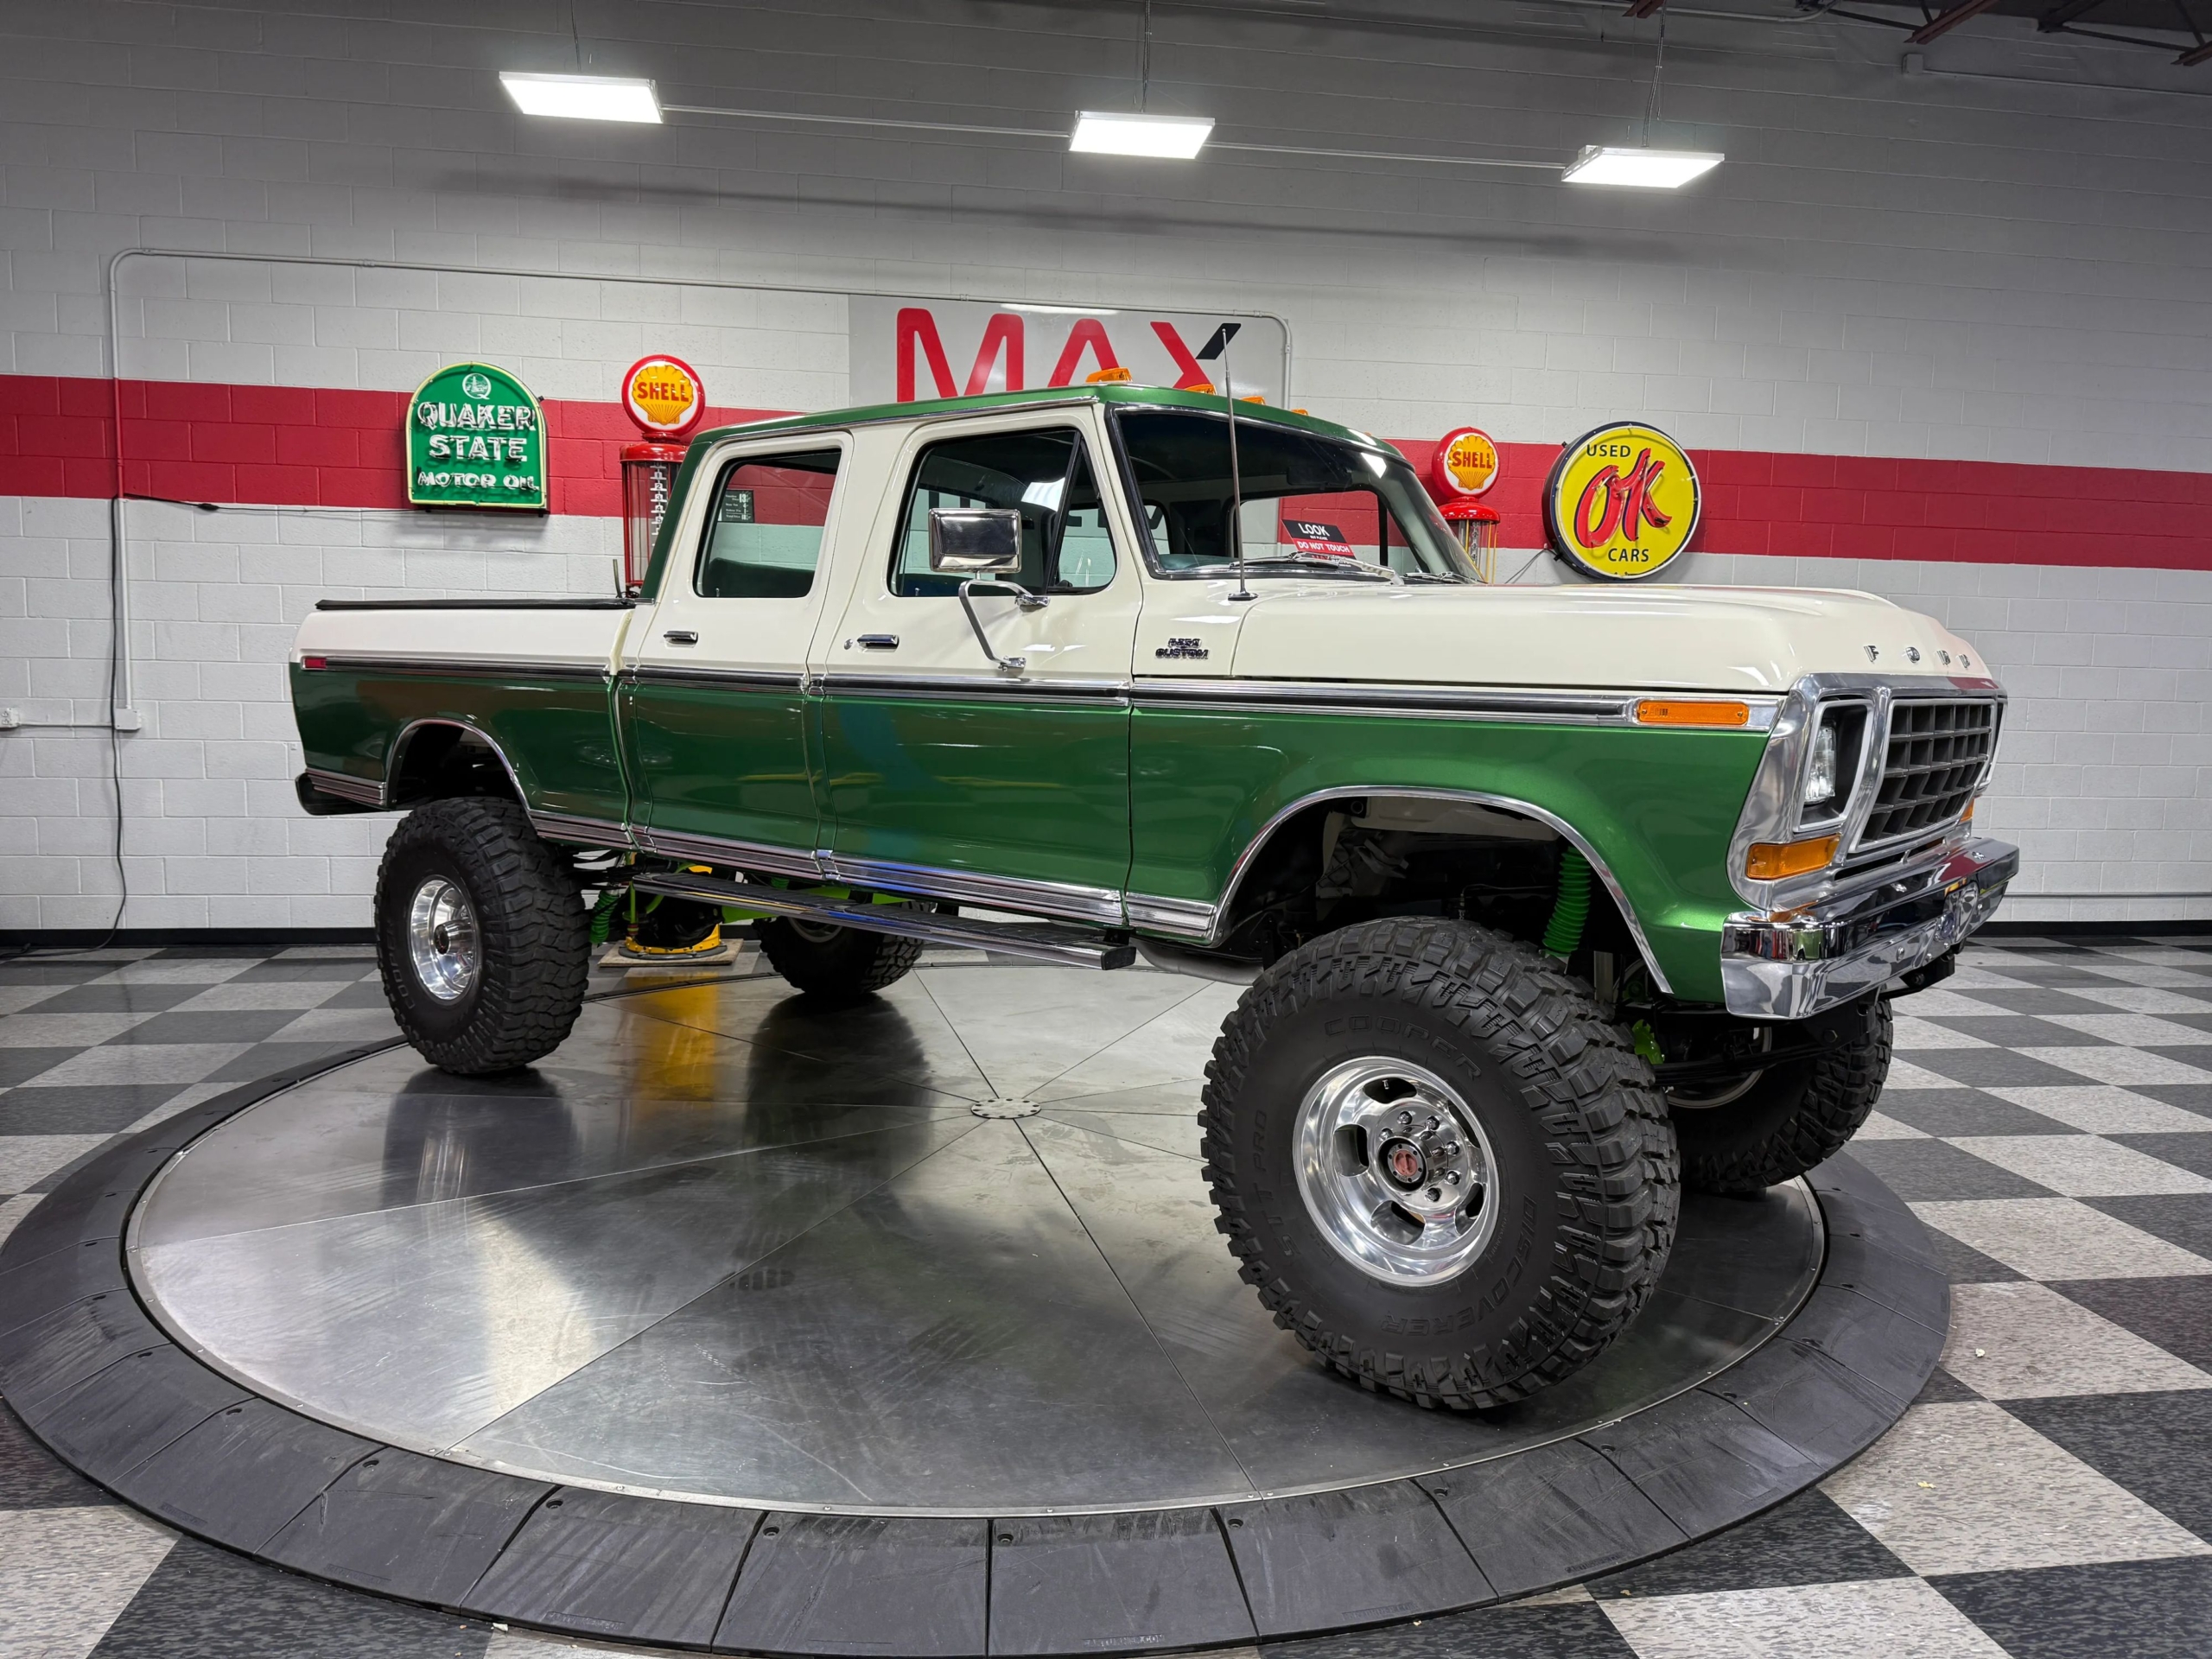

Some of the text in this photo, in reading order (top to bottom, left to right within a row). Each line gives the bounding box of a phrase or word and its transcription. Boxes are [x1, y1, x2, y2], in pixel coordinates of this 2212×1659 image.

[897, 307, 1242, 403] MAX
[637, 381, 690, 403] SHELL
[416, 401, 537, 431] QUAKER
[429, 434, 528, 462] STATE
[1586, 444, 1631, 458] USED
[1452, 450, 1493, 469] SHELL
[417, 471, 540, 491] MOTOR OIL
[1573, 447, 1673, 549] OK
[1298, 523, 1331, 537] LOOK
[1297, 541, 1351, 553] DO NOT TOUCH
[1608, 548, 1649, 563] CARS
[1155, 647, 1209, 659] CUSTOM
[1863, 645, 1971, 669] FORD
[1324, 1014, 1483, 1081] COOPER
[1380, 1192, 1537, 1337] DISCOVERER
